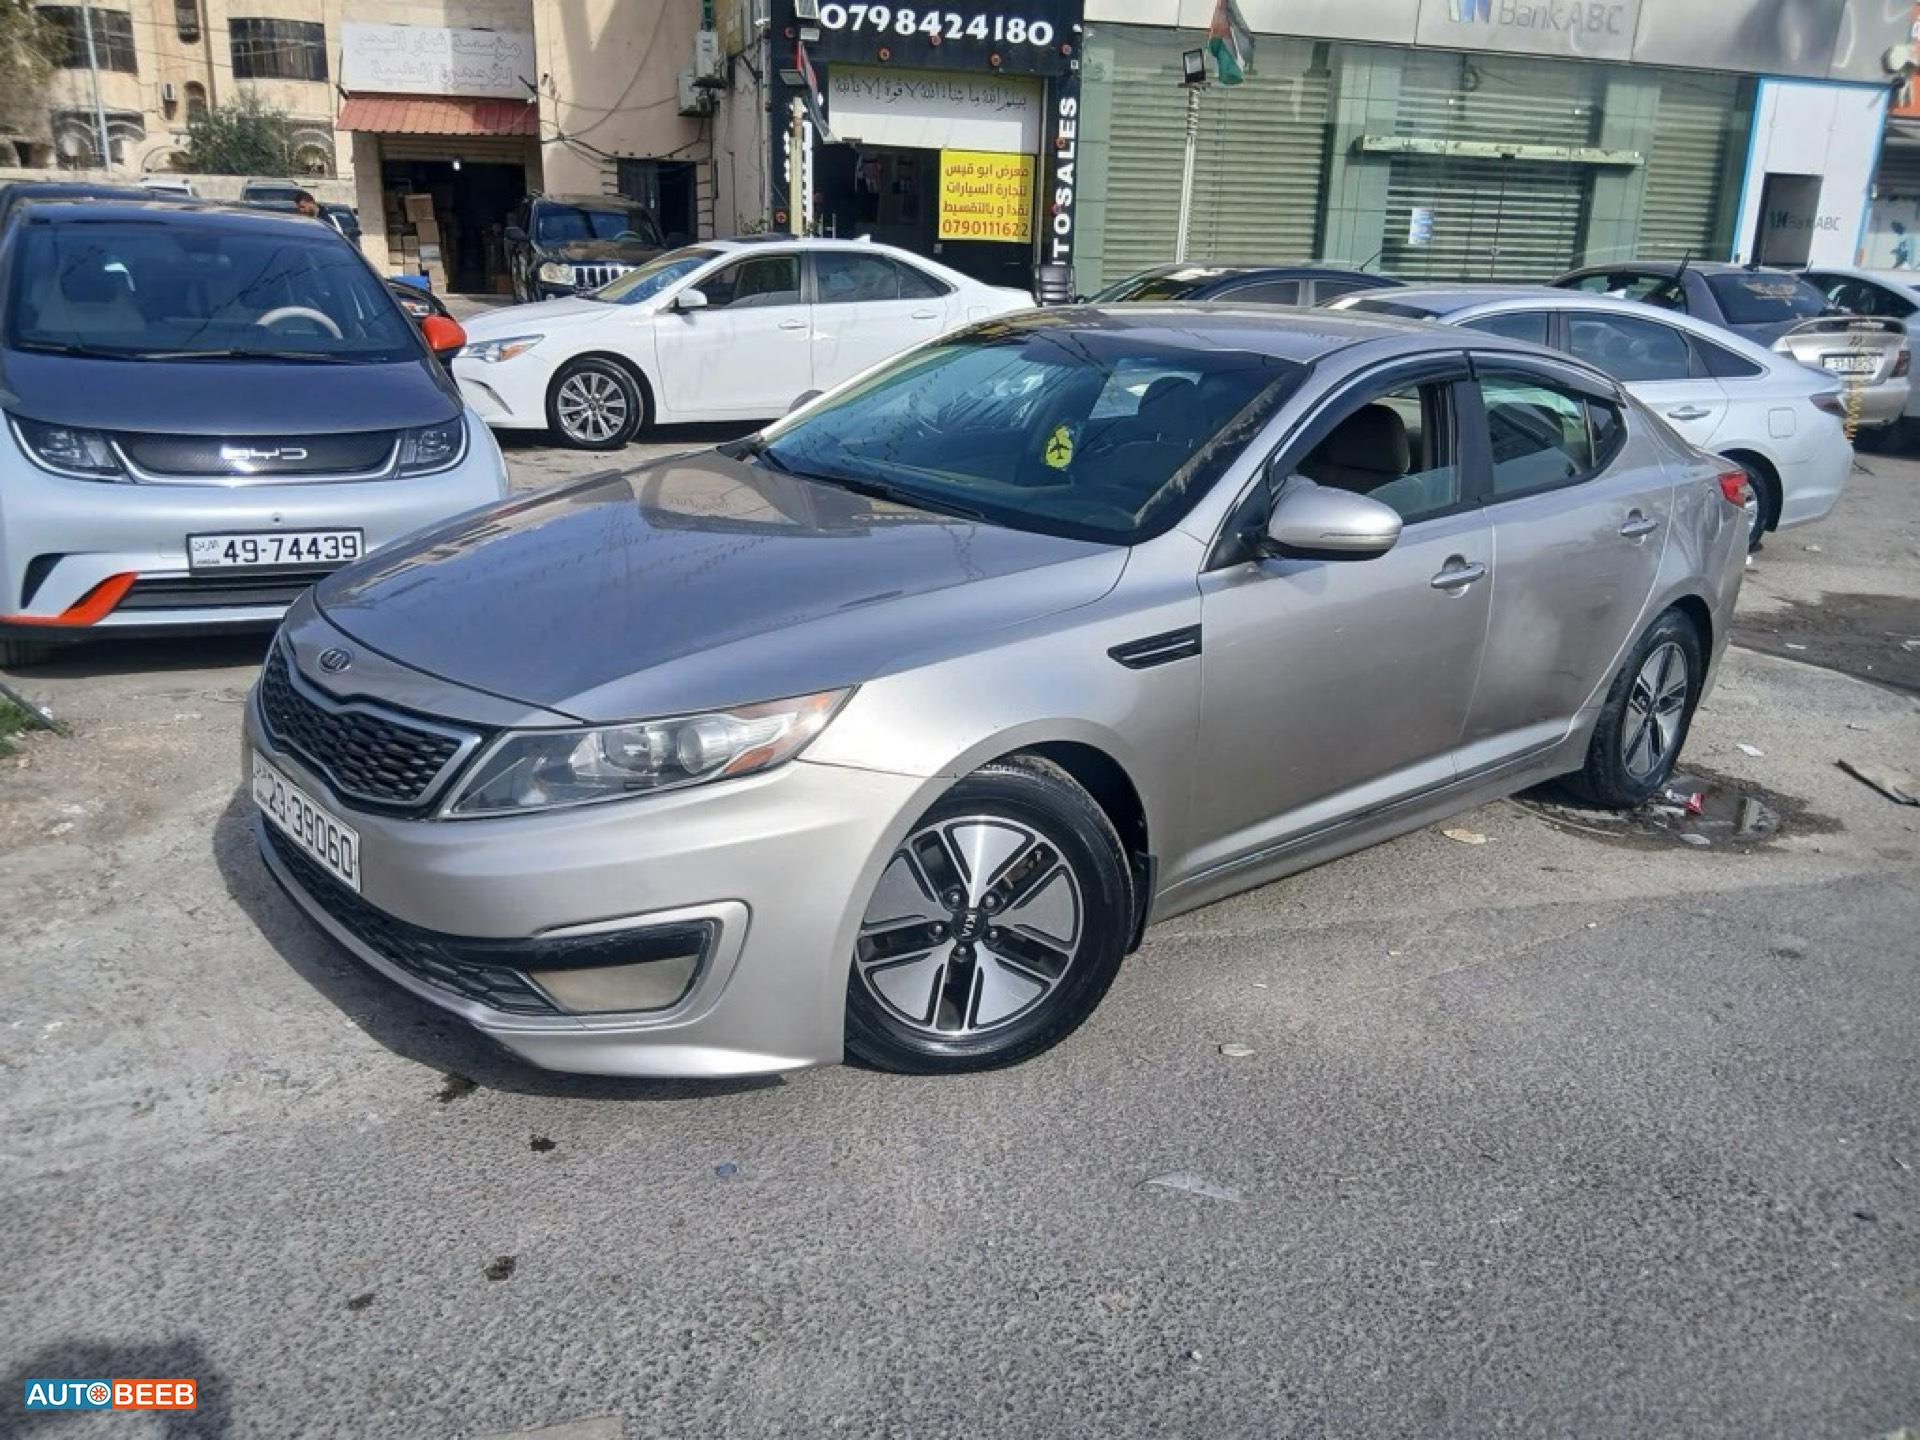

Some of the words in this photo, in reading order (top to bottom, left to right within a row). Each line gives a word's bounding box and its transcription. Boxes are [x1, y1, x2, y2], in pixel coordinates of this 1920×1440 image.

[820, 3, 1054, 46] 0798424180
[945, 163, 974, 177] قيس
[995, 165, 1029, 180] معرض
[946, 181, 993, 197] السيارات
[995, 183, 1027, 199] لتجارة
[943, 200, 995, 217] بالتقسيط
[997, 206, 1004, 218] و
[942, 218, 1029, 237] 0790111622
[223, 535, 358, 564] 49-74439
[269, 780, 353, 880] 23-39060
